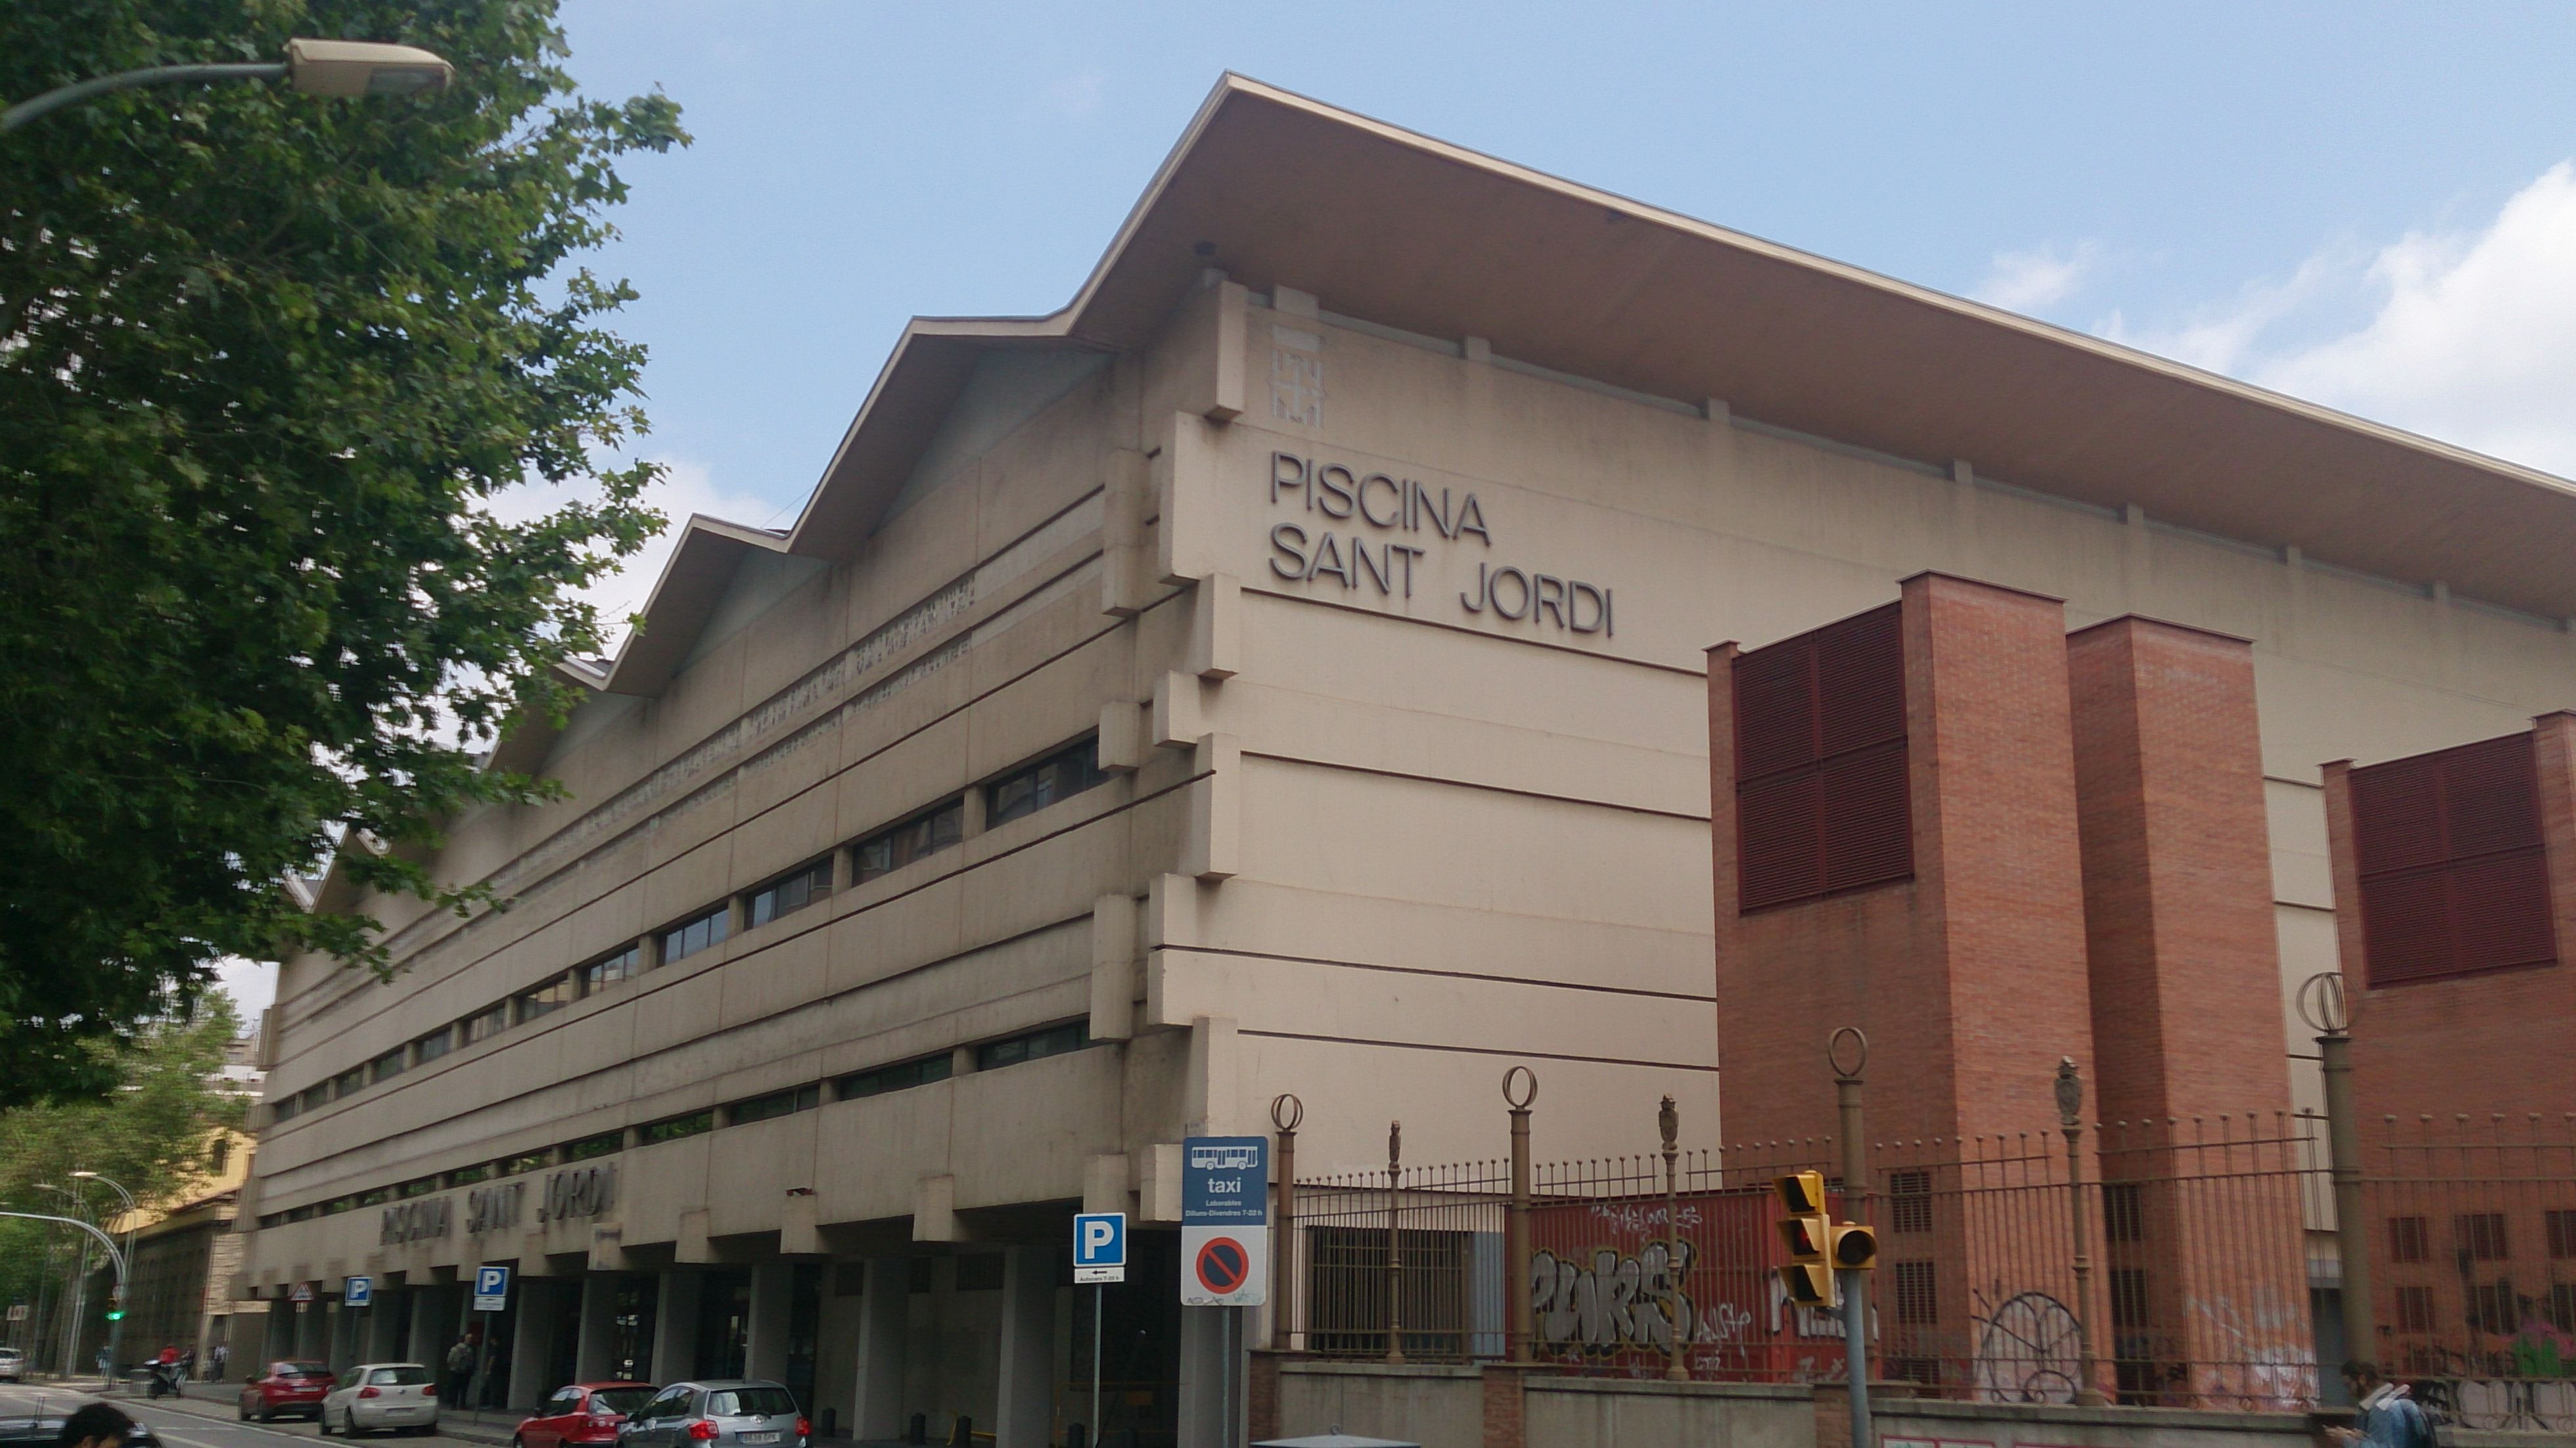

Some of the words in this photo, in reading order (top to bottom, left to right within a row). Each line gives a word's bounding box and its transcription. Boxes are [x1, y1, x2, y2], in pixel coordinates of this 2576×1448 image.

[1271, 449, 1492, 547] PISCINA
[1268, 522, 1425, 599] SANT
[1460, 562, 1614, 639] JORDI
[1208, 1177, 1241, 1193] taxi
[1084, 1221, 1115, 1259] P
[350, 1280, 368, 1298] P
[481, 1271, 502, 1293] P
